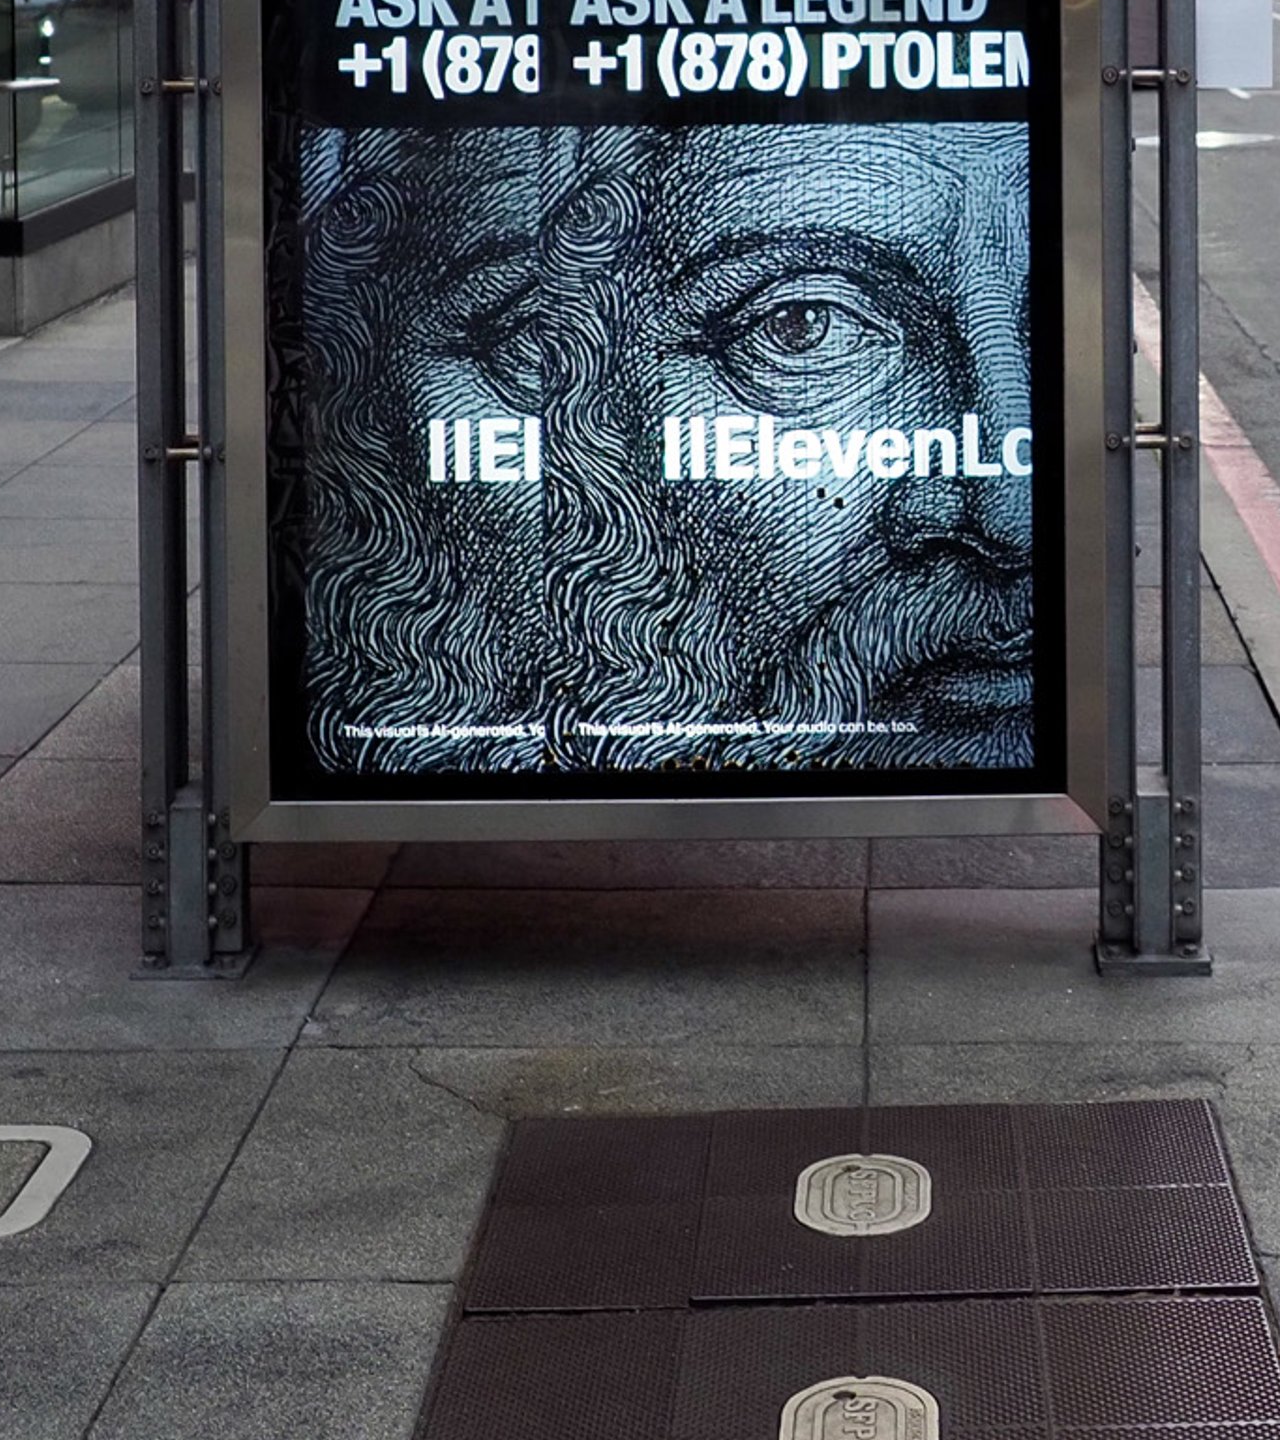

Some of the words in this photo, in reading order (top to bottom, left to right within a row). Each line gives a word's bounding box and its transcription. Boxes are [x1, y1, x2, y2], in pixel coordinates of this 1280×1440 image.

[338, 36, 407, 93] +1
[573, 33, 643, 92] +1
[657, 26, 808, 98] (878)
[344, 723, 373, 738] This
[374, 724, 416, 738] visual
[578, 722, 608, 736] This
[609, 722, 649, 736] visual
[762, 720, 794, 733] Your
[796, 720, 837, 733] audio
[838, 721, 865, 733] can
